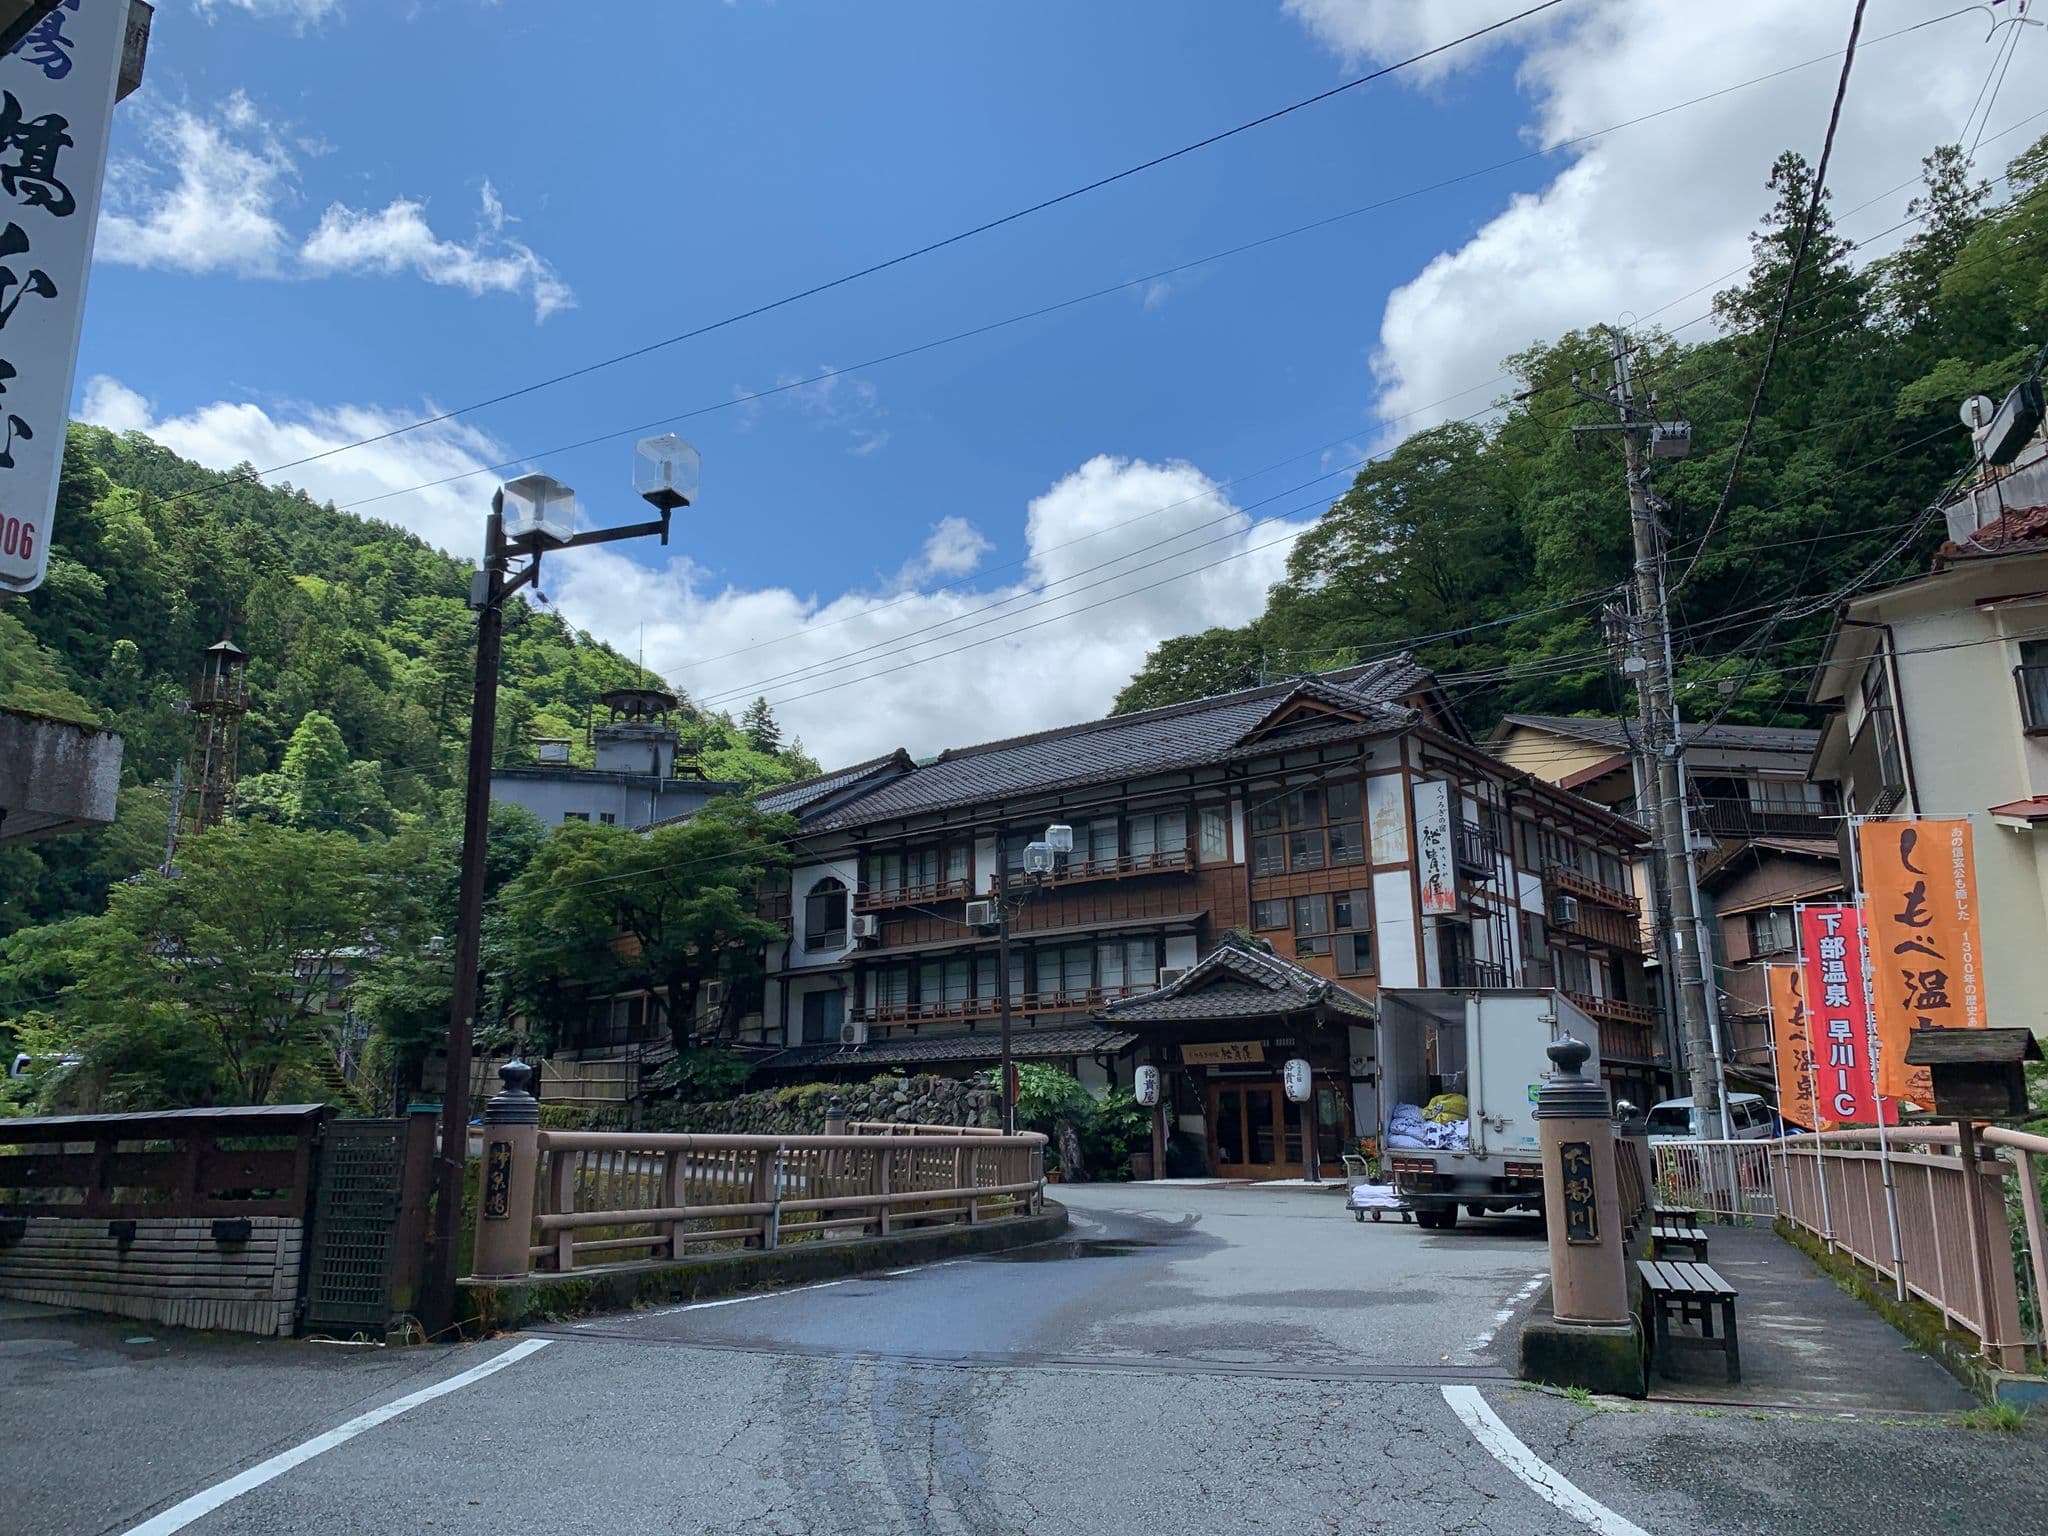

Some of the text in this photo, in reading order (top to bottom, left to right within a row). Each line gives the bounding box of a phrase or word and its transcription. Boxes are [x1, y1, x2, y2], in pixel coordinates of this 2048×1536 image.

[1817, 913, 1856, 1117] 下部温泉 早川IC
[1564, 1147, 1596, 1237] 下部川
